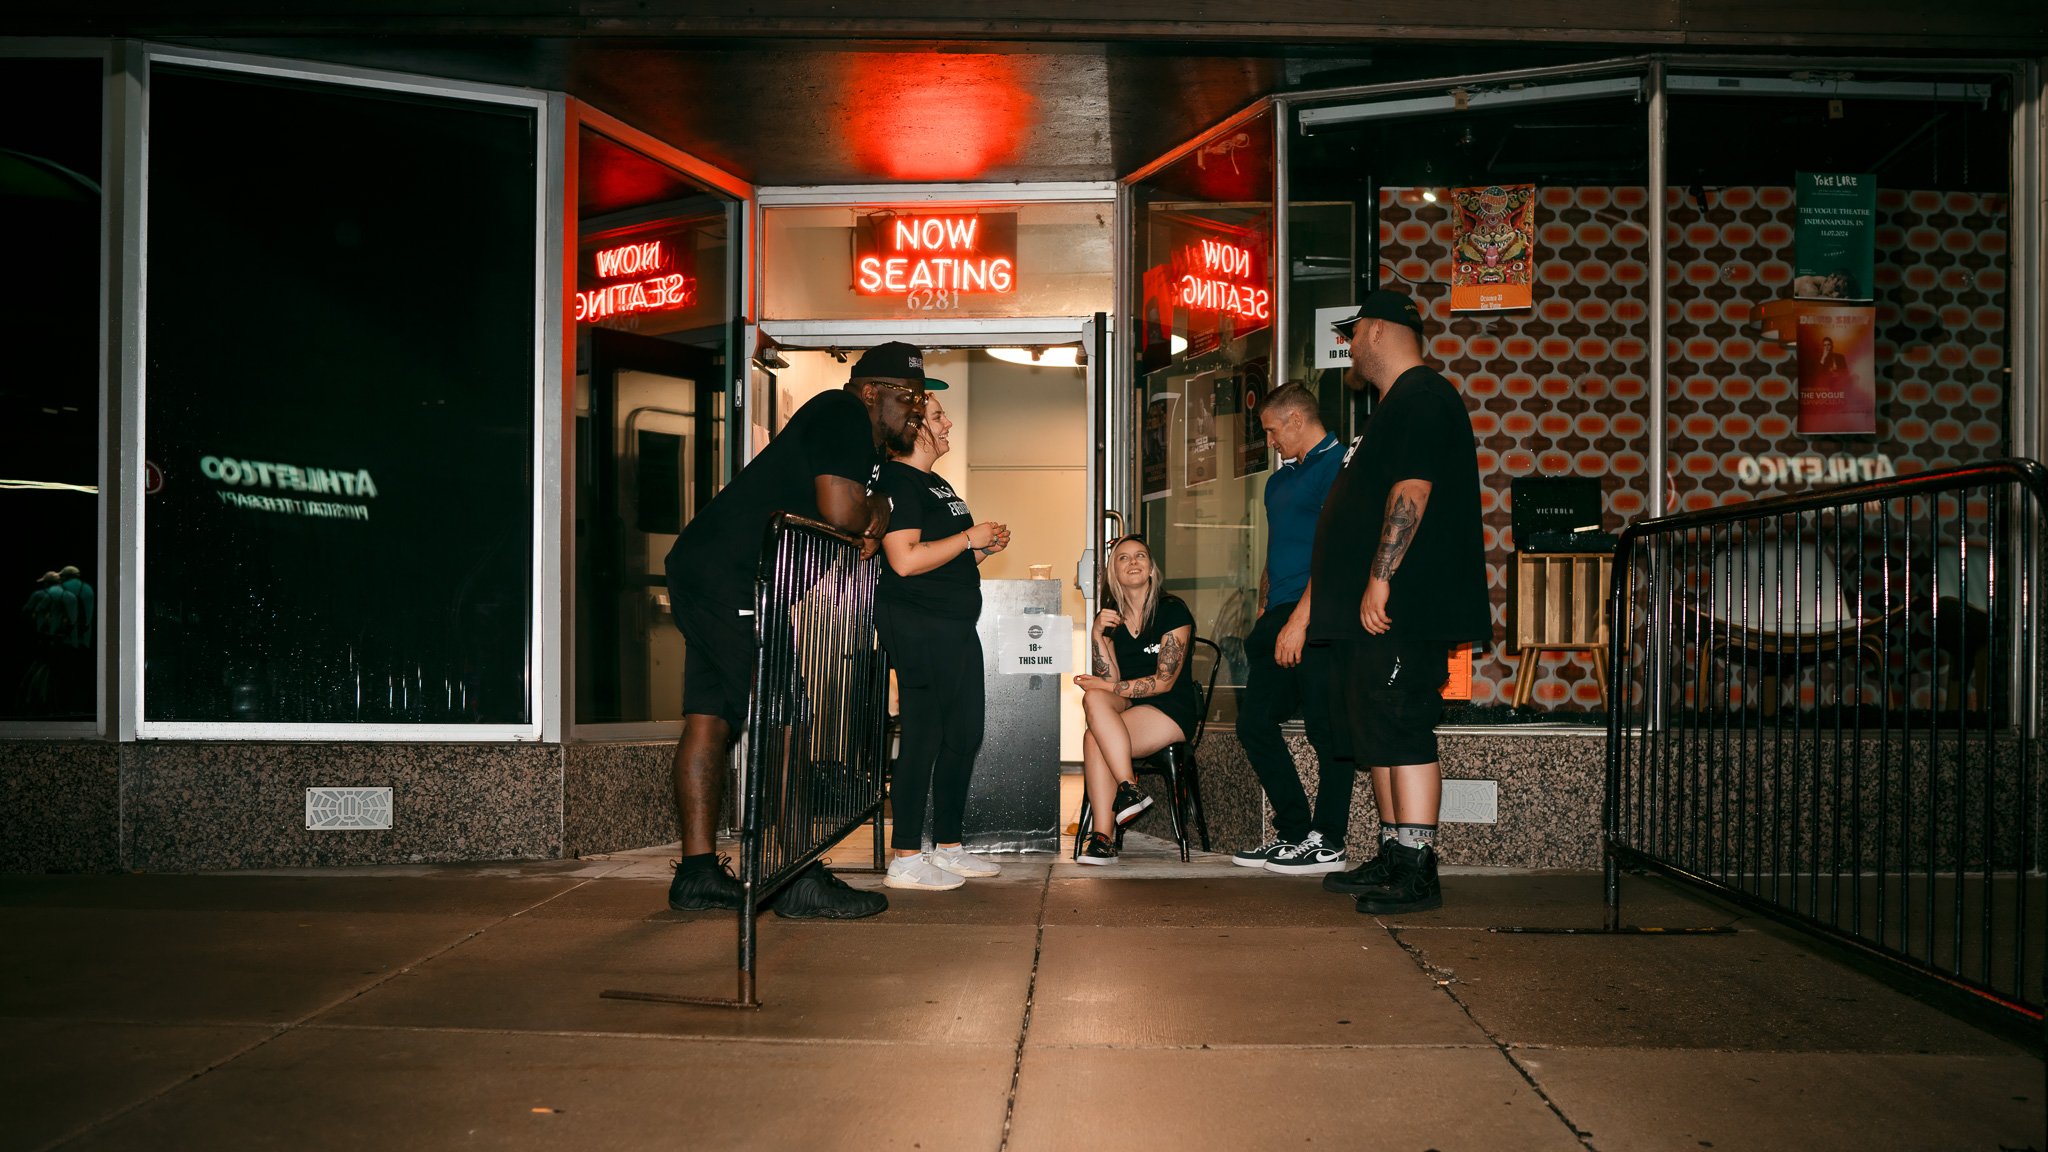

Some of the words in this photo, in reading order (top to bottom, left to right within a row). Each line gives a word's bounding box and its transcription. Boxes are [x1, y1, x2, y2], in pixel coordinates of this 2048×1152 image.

[1814, 207, 1838, 215] VOGUE
[1839, 208, 1870, 216] THEATRE
[896, 218, 976, 251] NOW
[859, 257, 1012, 291] SEATING
[906, 289, 961, 311] 6281
[1329, 350, 1338, 359] ID
[1800, 391, 1814, 399] THE
[1815, 391, 1845, 399] VOGUE
[1536, 507, 1574, 515] VICTROLA
[1028, 643, 1043, 652] 18+
[1018, 656, 1036, 665] THIS
[1037, 656, 1053, 665] LINE
